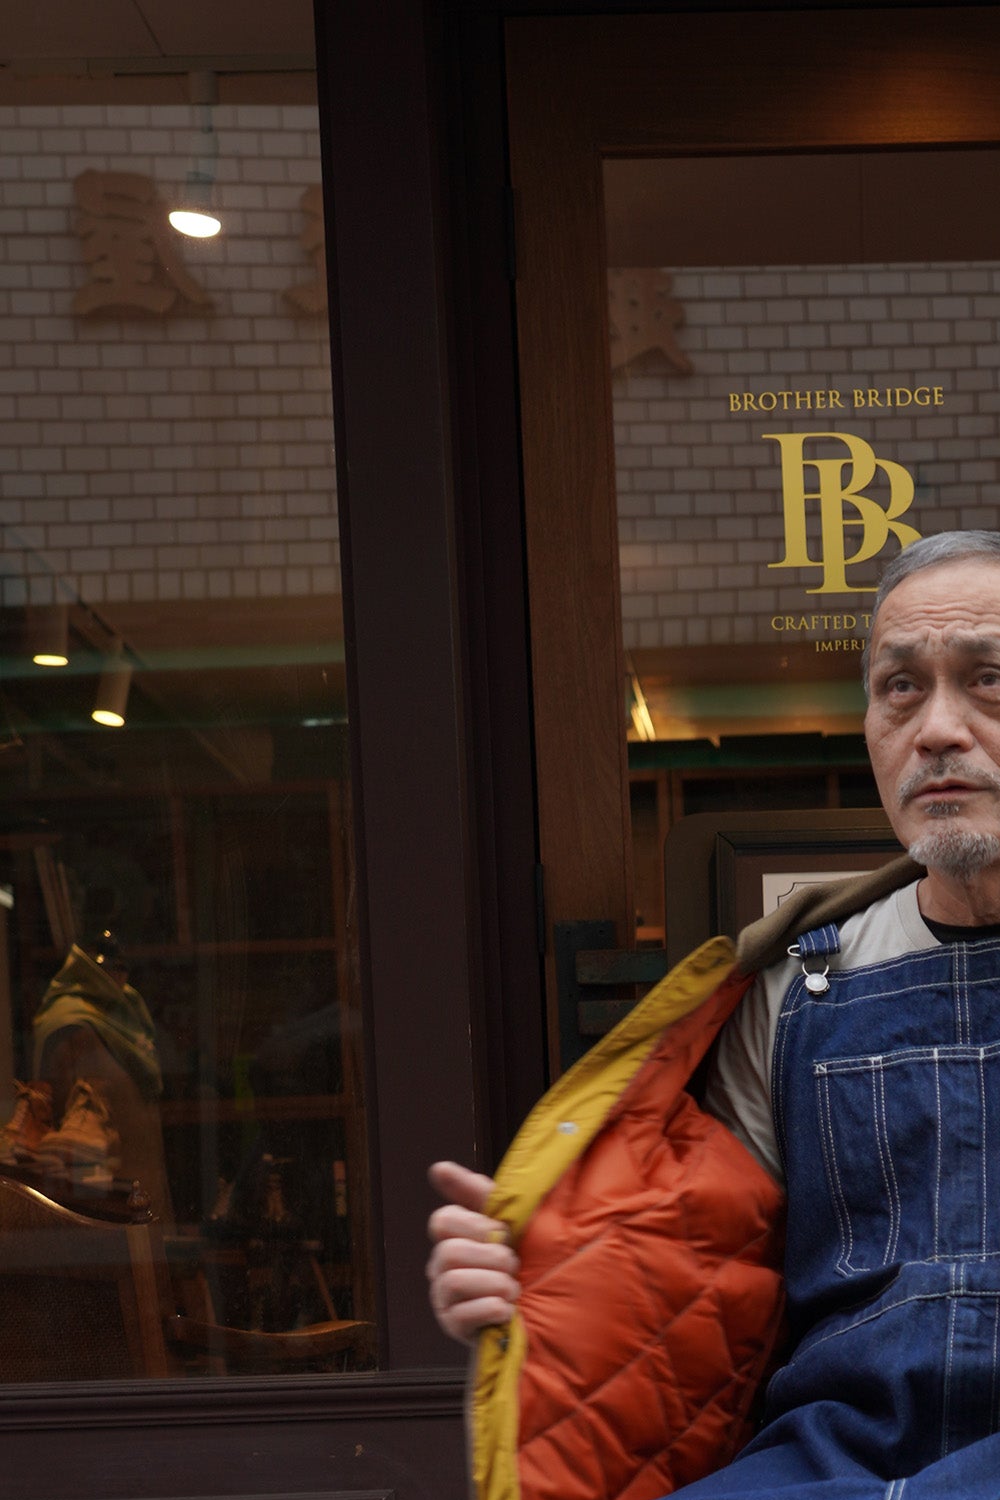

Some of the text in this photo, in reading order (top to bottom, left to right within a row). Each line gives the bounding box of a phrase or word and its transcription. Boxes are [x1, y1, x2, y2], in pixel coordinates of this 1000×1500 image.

[729, 386, 944, 412] BROTHER BRIDGE
[771, 614, 873, 631] CRAFTED T
[815, 639, 866, 652] IMPERI
